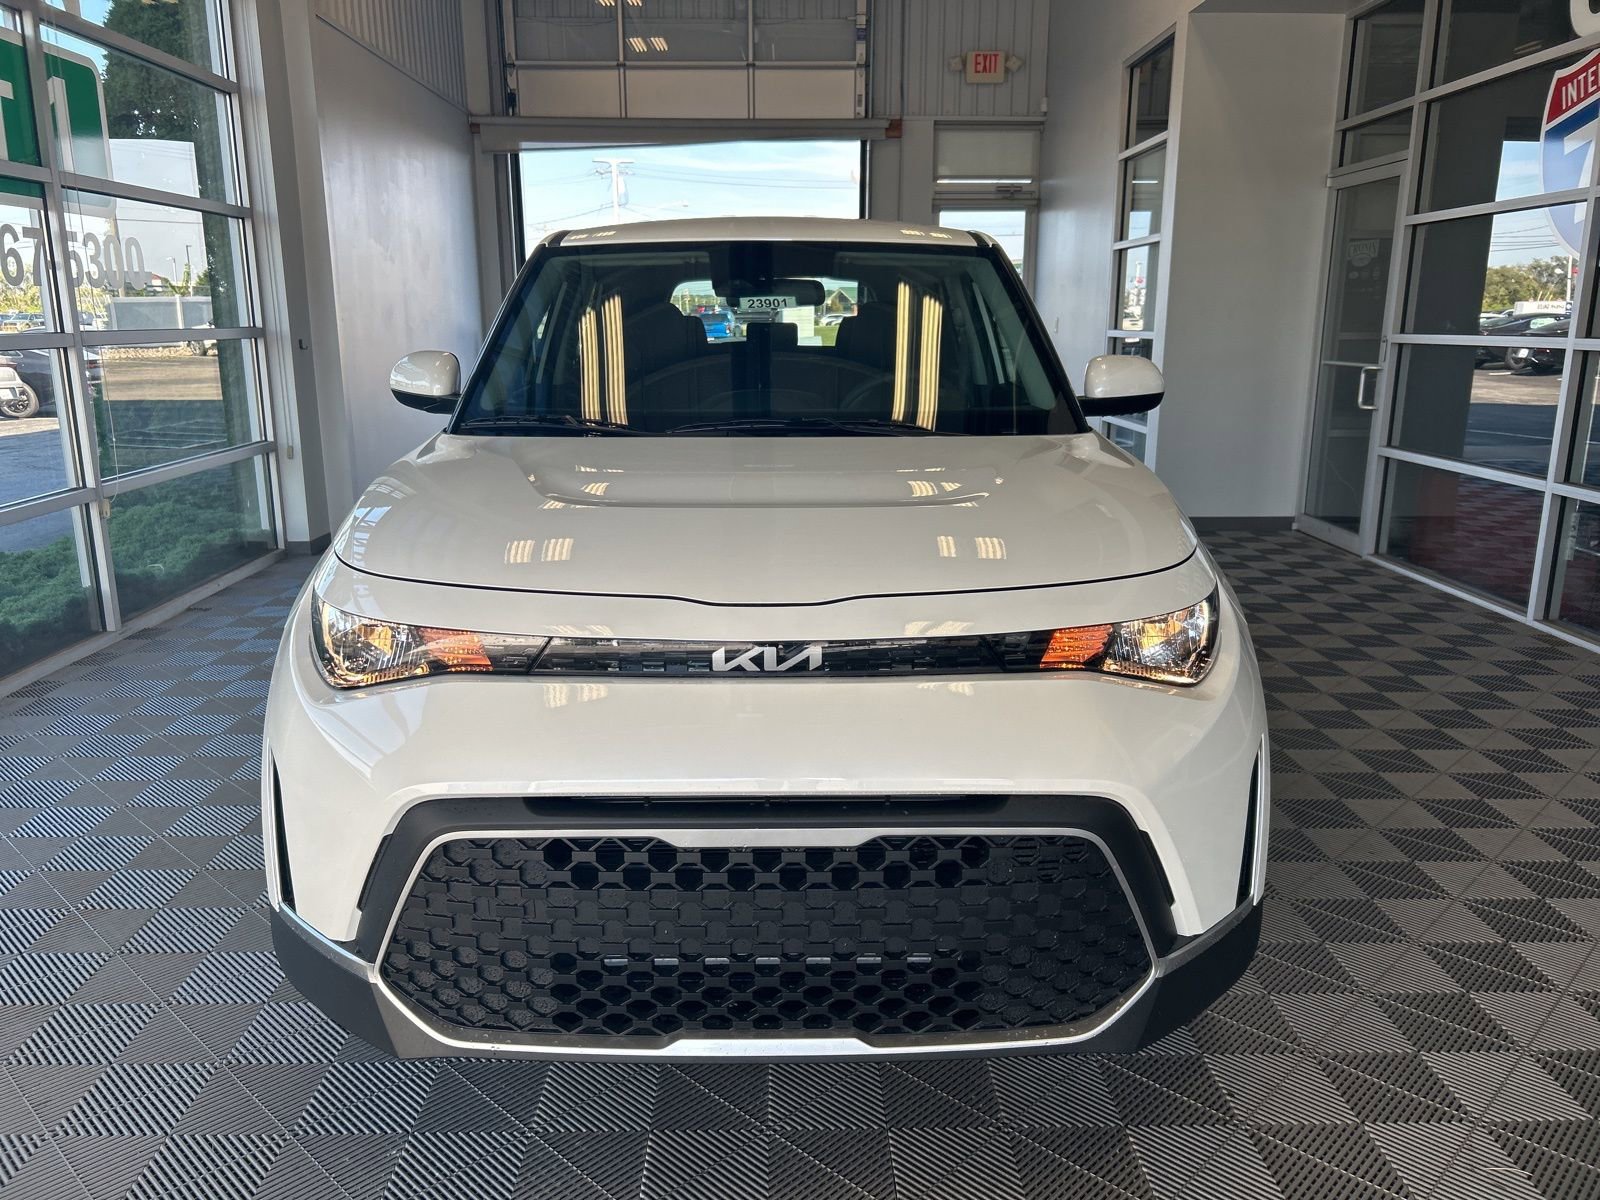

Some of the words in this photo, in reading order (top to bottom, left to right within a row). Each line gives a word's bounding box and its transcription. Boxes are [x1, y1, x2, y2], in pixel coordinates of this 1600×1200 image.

[974, 53, 1000, 74] EXIT
[747, 298, 787, 309] 23901
[711, 646, 823, 672] KIA
